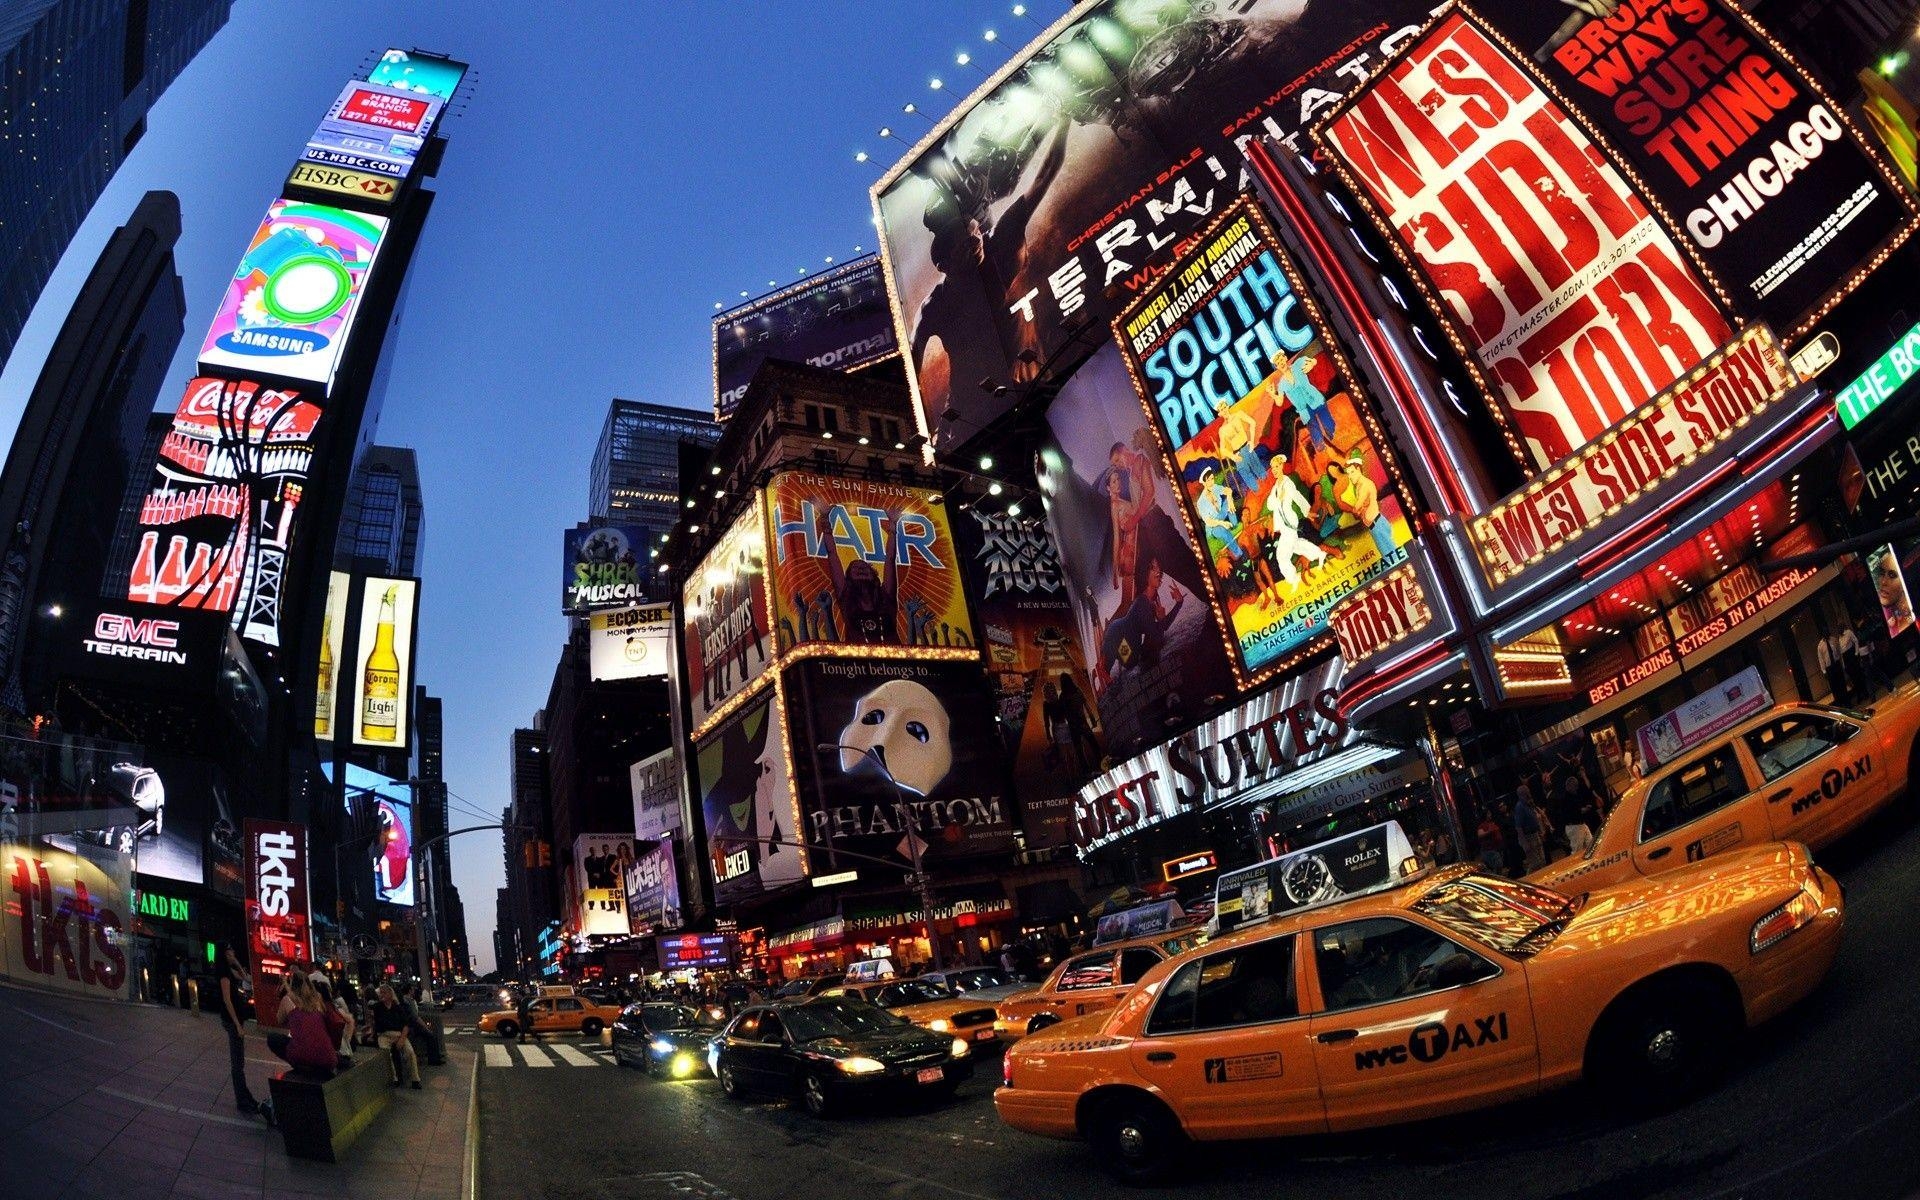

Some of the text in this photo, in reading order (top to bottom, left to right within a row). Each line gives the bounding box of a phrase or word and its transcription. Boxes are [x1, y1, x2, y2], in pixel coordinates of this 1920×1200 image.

[1222, 22, 1389, 137] SAM WORTHINGTON
[1614, 15, 1749, 136] SURE
[1327, 13, 1534, 213] WEST
[1644, 55, 1797, 187] THING
[294, 167, 360, 190] HSBC
[307, 150, 400, 174] US.HSBC.COM
[1687, 104, 1842, 248] CHICAGO
[1067, 147, 1203, 251] CHRISTIAN BALE
[1400, 101, 1651, 341] SIDE
[765, 283, 829, 315] breathtaking
[1127, 292, 1171, 338] WINNER!
[1169, 283, 1178, 298] 7
[1178, 260, 1208, 288] TONY
[1208, 217, 1250, 263] AWARDS
[1132, 232, 1261, 354] BEST MUSICAL REVIVAL
[1140, 322, 1182, 362] RODGERS
[1191, 244, 1266, 314] HAMMERSTEIN'S
[231, 329, 315, 355] SAMSUNG
[1145, 251, 1291, 401] SOUTH
[1482, 279, 1585, 362] TICKETMASTER.COM
[1160, 295, 1314, 449] PACIFIC
[1836, 362, 1895, 423] THE
[797, 474, 825, 487] THE
[832, 479, 861, 492] SUN
[869, 483, 912, 499] SHINE
[1493, 469, 1589, 567] WEST
[1586, 410, 1685, 513] SIDE
[1675, 338, 1777, 450] STORY
[1866, 450, 1908, 499] THE
[774, 499, 947, 570] HAIR
[573, 562, 643, 590] SHREK
[576, 583, 643, 603] MUSICAL
[1241, 547, 1407, 651] LINCOLN CENTER THEATE
[1269, 593, 1303, 618] DIRECTED
[1304, 589, 1316, 599] BY
[1316, 564, 1354, 591] BARTLETT
[1356, 550, 1376, 569] SHER
[83, 639, 187, 665] TERRAIN
[95, 613, 179, 647] GMC
[703, 597, 753, 667] JERSEY BOYS
[1264, 636, 1286, 651] TAKE
[1286, 625, 1305, 641] THE
[1333, 577, 1413, 661] STORY
[1589, 677, 1619, 704] BEST
[1624, 649, 1674, 686] LEADING
[1730, 607, 1744, 626] IN
[1746, 601, 1756, 615] A
[1756, 567, 1818, 610] MUSICAL...
[819, 661, 914, 679] Tonight belongs
[1168, 687, 1349, 806] SUITES
[810, 796, 1004, 843] PHANTOM
[1334, 788, 1367, 812] GUEST
[1368, 773, 1405, 797] SUITES
[1791, 790, 1822, 816] NYC
[259, 830, 297, 918] tkts
[1344, 847, 1382, 866] ROLEX
[11, 855, 126, 991] tkts
[1354, 1012, 1509, 1071] NYC TAXI
